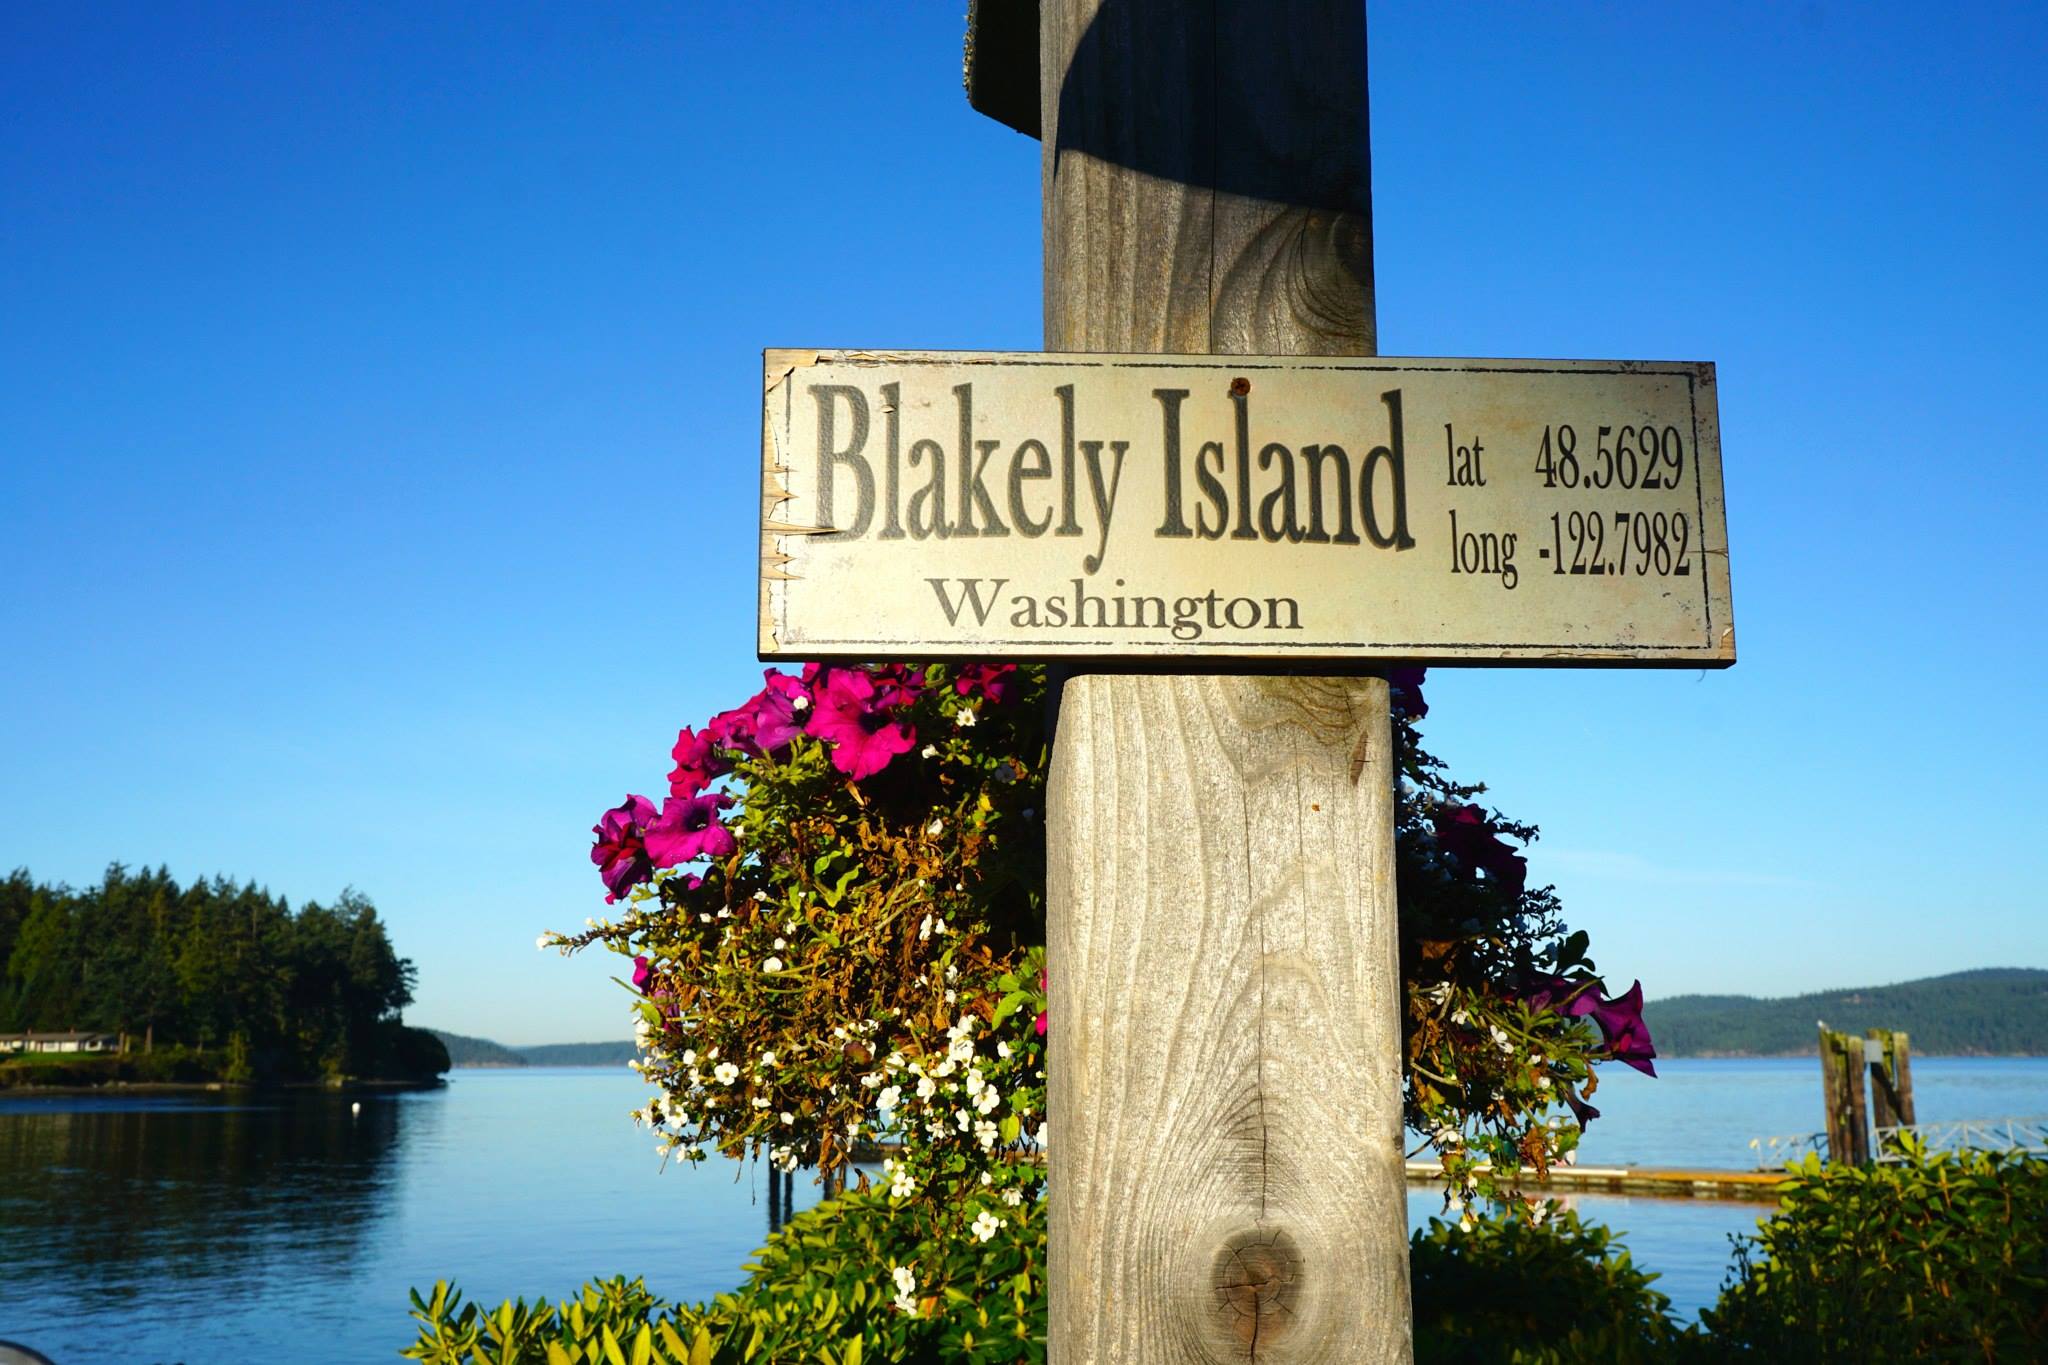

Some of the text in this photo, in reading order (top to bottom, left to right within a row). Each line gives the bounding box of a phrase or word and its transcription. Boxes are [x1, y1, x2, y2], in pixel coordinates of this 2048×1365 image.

[806, 380, 1416, 576] Blakely Island
[1444, 423, 1684, 490] lat 48.5629
[1448, 508, 1691, 591] long -122.7982
[923, 578, 1304, 641] Washington
